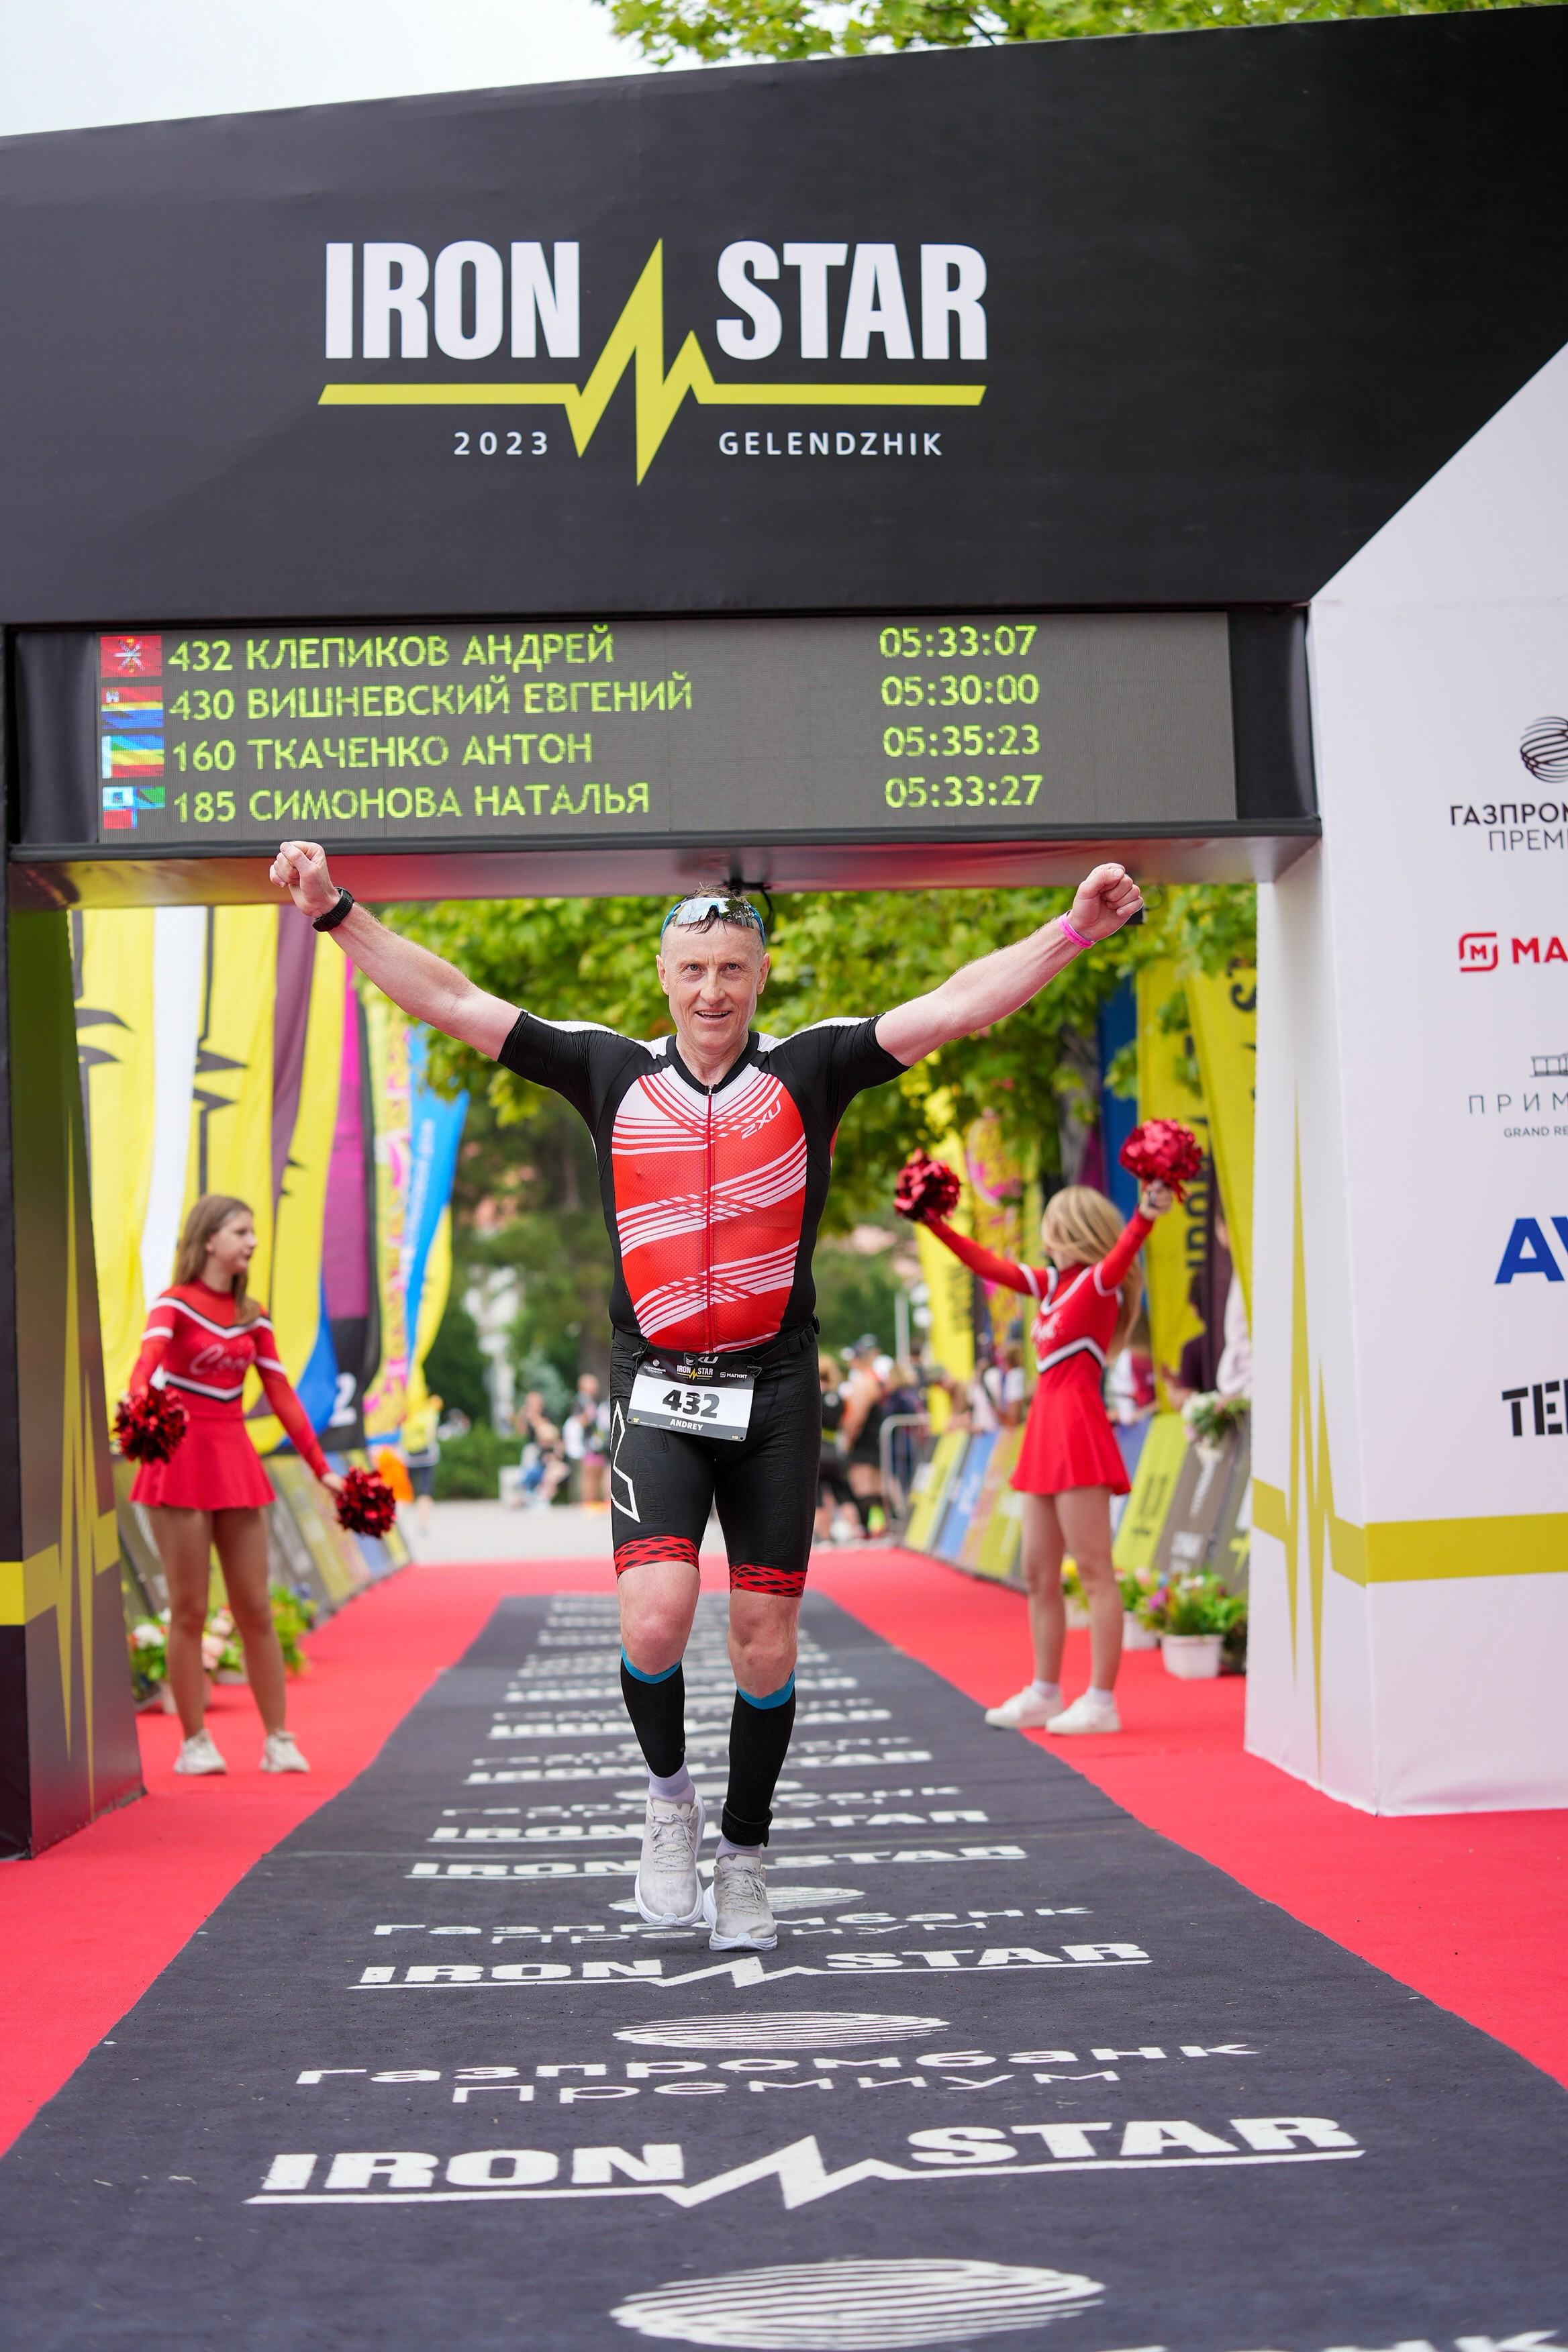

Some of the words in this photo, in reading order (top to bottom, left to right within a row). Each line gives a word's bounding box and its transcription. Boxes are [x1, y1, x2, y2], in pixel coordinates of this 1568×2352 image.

[325, 240, 580, 360] IRON
[716, 240, 987, 360] STAR
[454, 431, 548, 456] 2023
[719, 432, 942, 456] GELENDZHIK
[168, 640, 234, 671] 432
[246, 635, 450, 670] КЛЕПИКОВ
[461, 624, 615, 673] АНДРЕЙ
[879, 624, 1038, 658] 05:33:07
[169, 688, 235, 721] 430
[246, 676, 511, 719] ВИШНЕВСКИЙ
[523, 671, 693, 714] ЕВГЕНИЙ
[881, 673, 1040, 706] 05:30:00
[173, 739, 236, 772] 160
[246, 735, 450, 770] ТКАЧЕНКО
[461, 732, 593, 766] АНТОН
[882, 724, 1041, 756] 05:35:23
[173, 791, 236, 823] 185
[248, 786, 464, 822] СИМОНОВА
[474, 781, 650, 816] НАТАЛЬЯ
[884, 773, 1044, 808] 05:33:27
[1451, 802, 1568, 826] ГАЗПРО
[1489, 828, 1568, 852] ПРЕМ
[741, 1099, 781, 1140] 2XU
[1504, 1126, 1550, 1138] GRAND
[677, 1364, 691, 1373] IRON
[697, 1367, 714, 1376] STAR
[662, 1389, 720, 1419] 432
[1502, 1378, 1568, 1437] TE
[669, 1418, 703, 1432] ANDREY
[411, 1860, 642, 1877] IRON
[774, 1845, 1027, 1867] STAR
[491, 1921, 987, 1945] Преиум
[360, 1959, 663, 1983] IRON
[826, 1943, 1150, 1969] STAR
[296, 2043, 1261, 2084] Газпромбанк
[452, 2069, 1121, 2104] Премиум
[262, 2143, 685, 2191] IRON
[908, 2116, 1358, 2165] STAR
